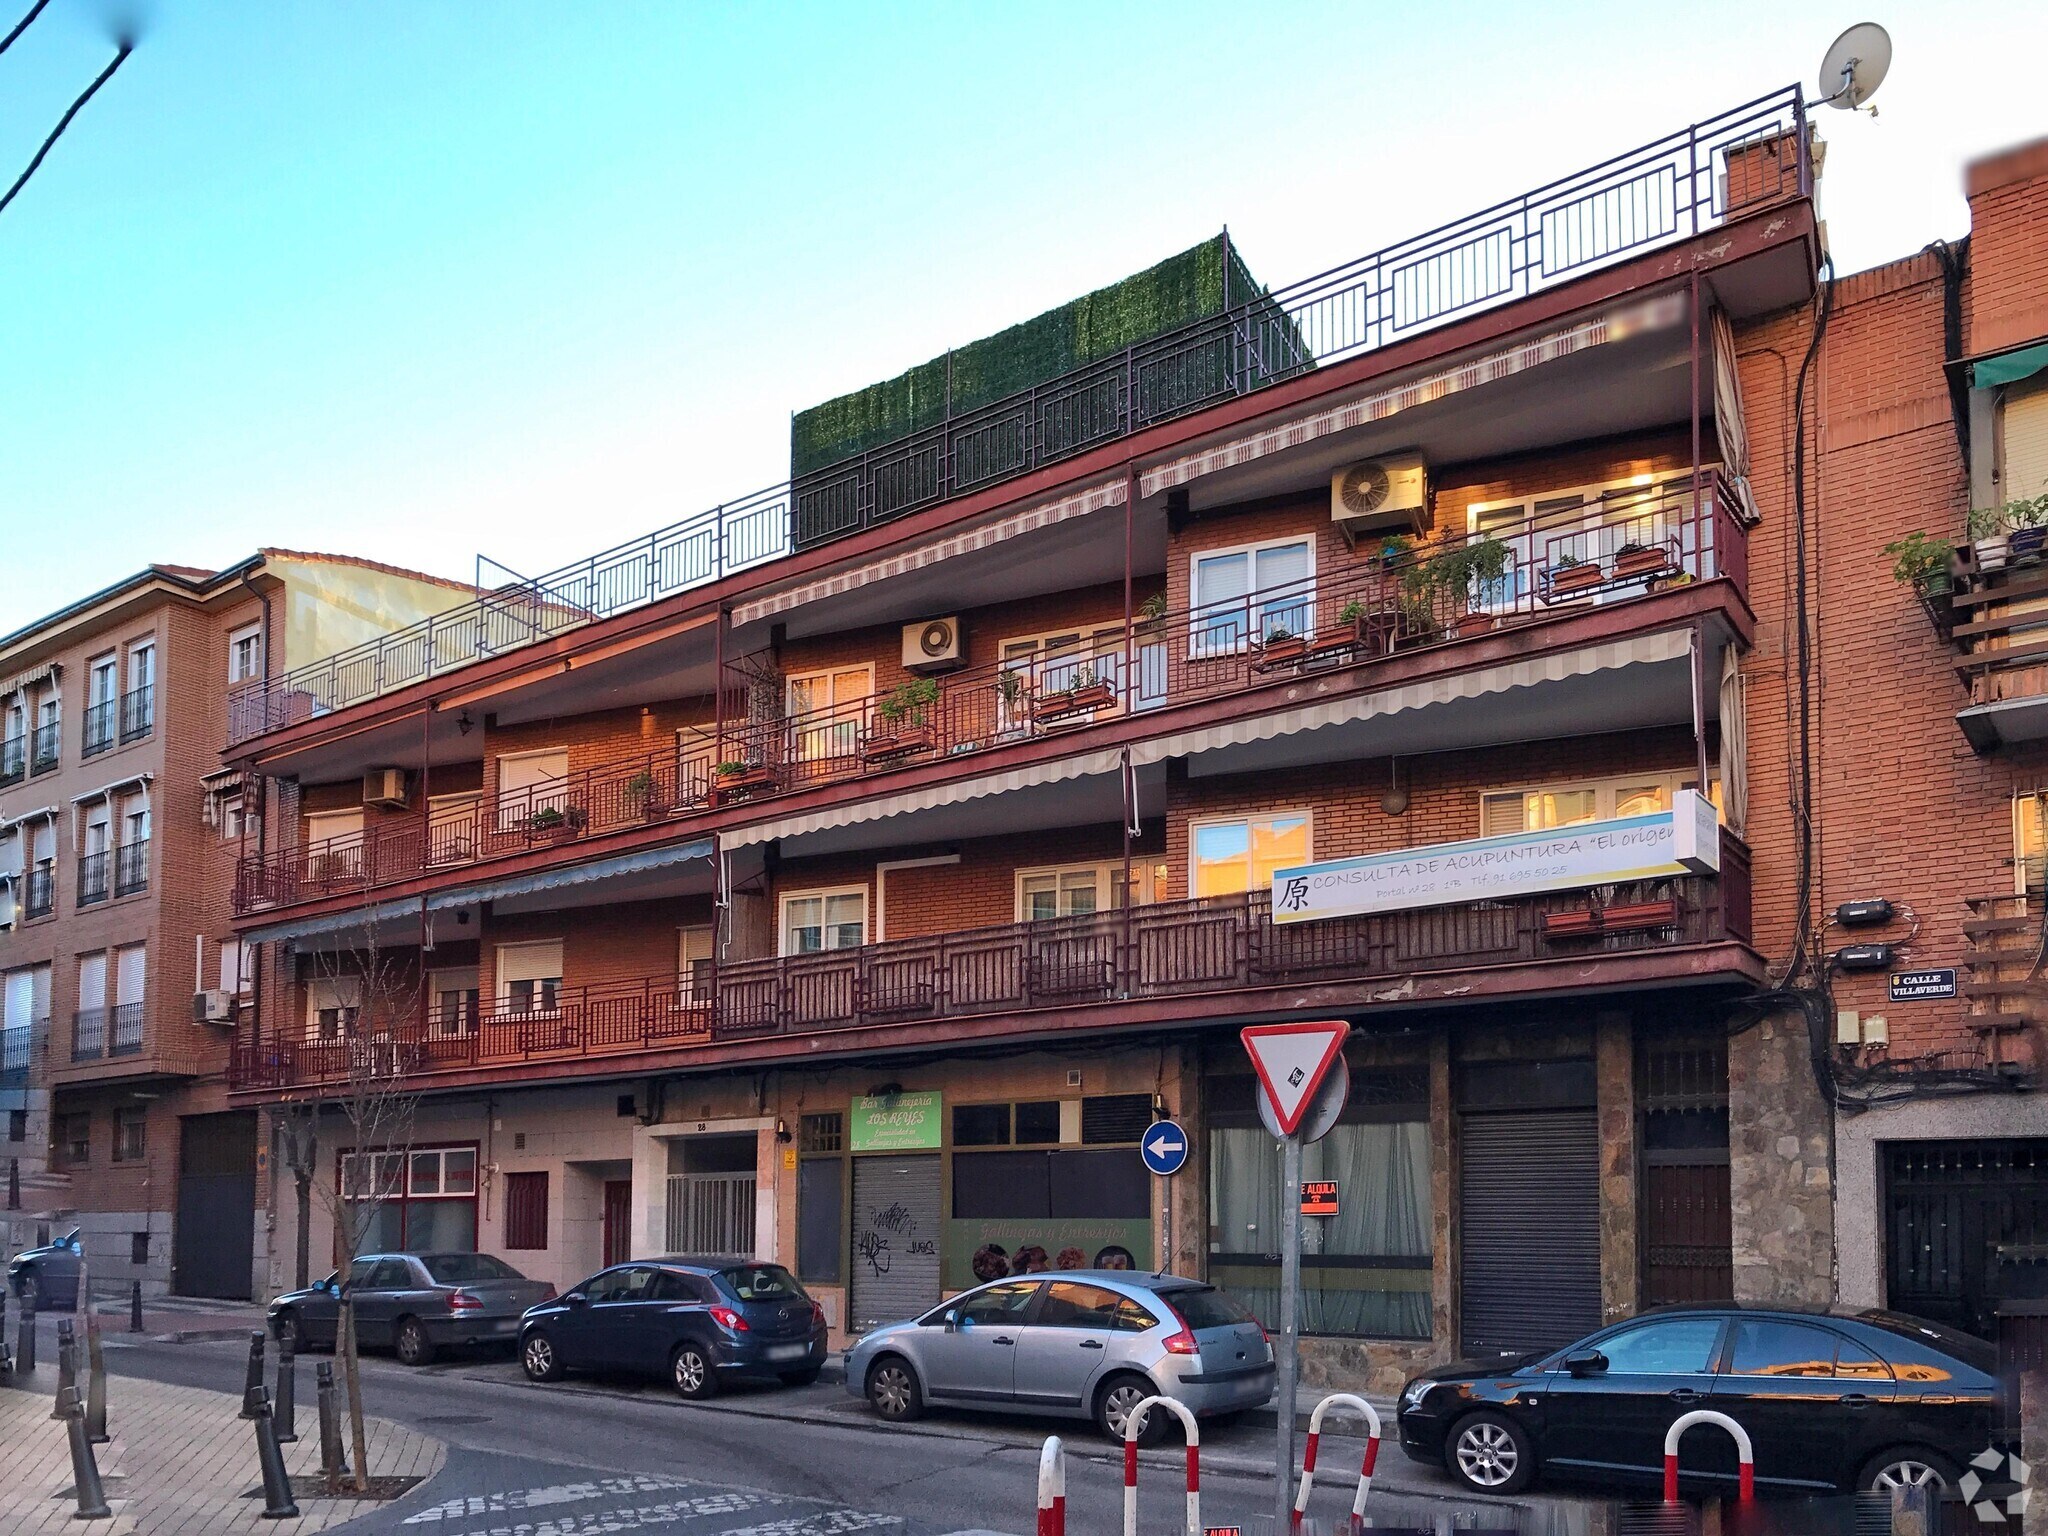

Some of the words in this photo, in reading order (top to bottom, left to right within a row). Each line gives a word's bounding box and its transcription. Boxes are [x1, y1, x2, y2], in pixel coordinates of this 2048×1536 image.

[1313, 864, 1411, 890] CONSULTA
[1416, 860, 1439, 875] DE
[1443, 840, 1582, 871] ACUPUNTURA
[1376, 886, 1406, 898] Portal
[1533, 868, 1549, 877] 50
[1551, 865, 1568, 875] 25
[1277, 875, 1309, 912] 原
[1902, 975, 1942, 985] CALLE
[1892, 984, 1953, 996] VILLAVERDE
[860, 1096, 878, 1109] Bar
[866, 1111, 888, 1125] LOS
[889, 1110, 925, 1126] REYES
[1307, 1183, 1336, 1195] ALQUILA
